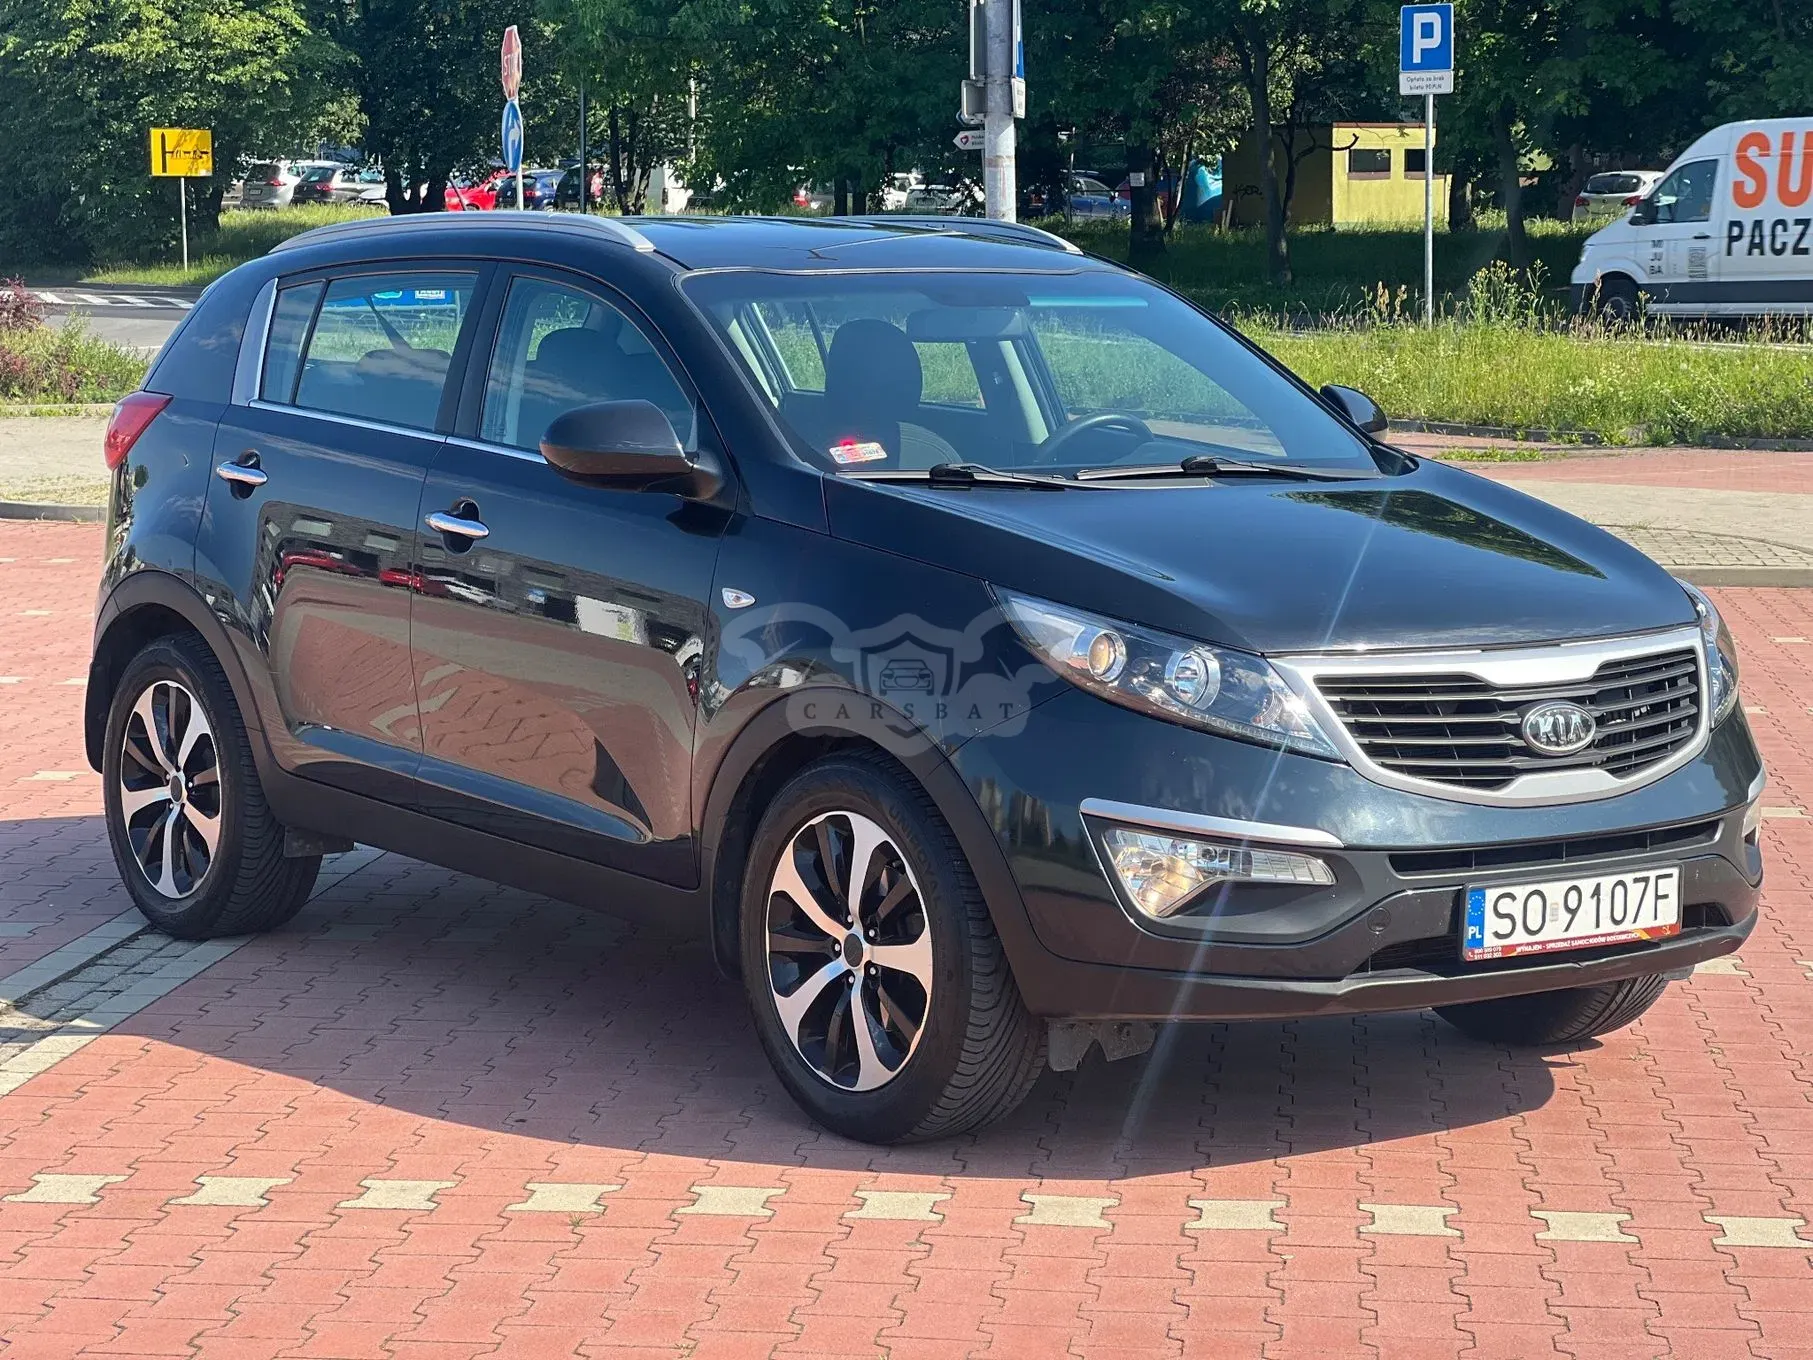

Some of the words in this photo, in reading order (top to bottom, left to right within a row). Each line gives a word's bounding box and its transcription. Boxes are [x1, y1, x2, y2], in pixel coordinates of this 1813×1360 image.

[1413, 12, 1441, 63] P
[1732, 131, 1813, 209] SU
[1726, 218, 1812, 257] PACZ
[1537, 714, 1586, 745] KIA
[1492, 889, 1547, 940] SO
[1562, 873, 1674, 933] 9107F
[1468, 926, 1482, 940] PL
